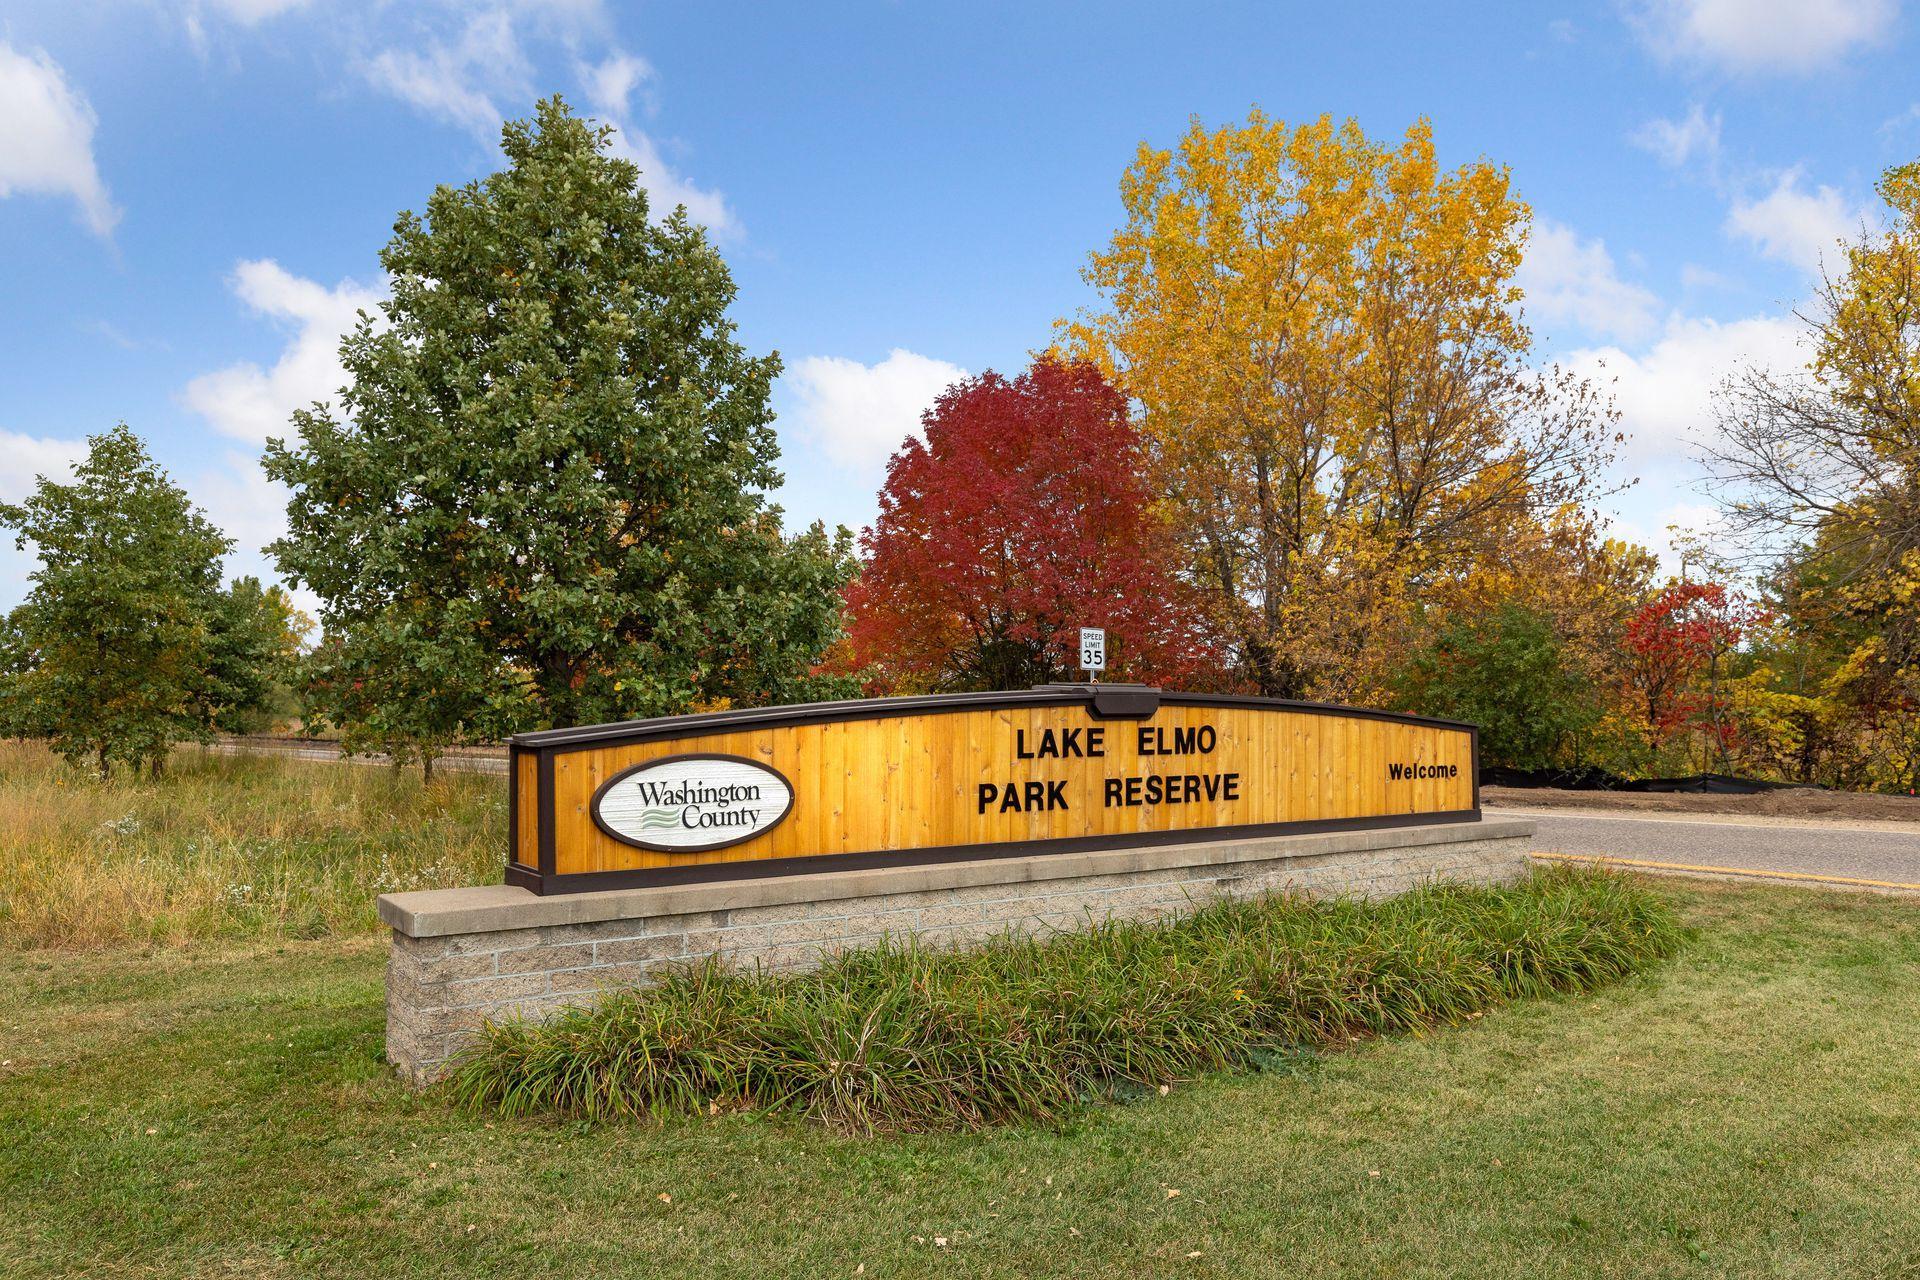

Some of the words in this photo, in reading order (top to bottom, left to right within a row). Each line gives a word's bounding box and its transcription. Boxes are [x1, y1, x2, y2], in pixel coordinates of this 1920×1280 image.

[1083, 650, 1102, 665] 35
[1017, 728, 1105, 759] LAKE
[1138, 725, 1217, 755] ELMO
[1389, 763, 1457, 780] Welcome
[637, 780, 761, 807] Washington
[978, 780, 1069, 814] PARK
[1105, 773, 1239, 807] RESERVE
[681, 805, 760, 829] County
